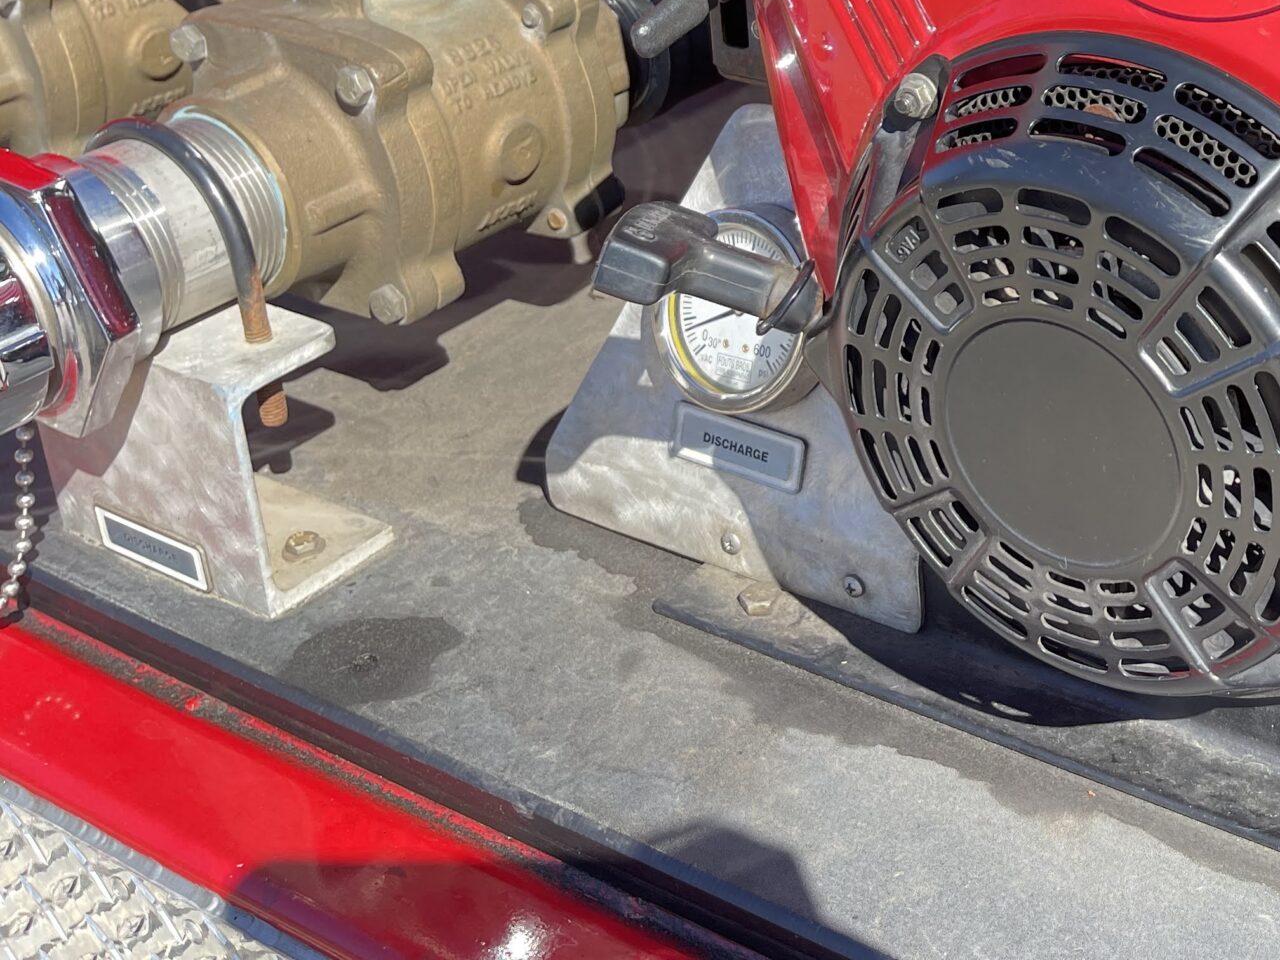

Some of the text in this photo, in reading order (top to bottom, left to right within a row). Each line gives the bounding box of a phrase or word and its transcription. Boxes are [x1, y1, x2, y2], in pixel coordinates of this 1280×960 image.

[702, 328, 709, 341] 0
[753, 344, 772, 358] 600
[703, 431, 770, 463] DISCHARGE
